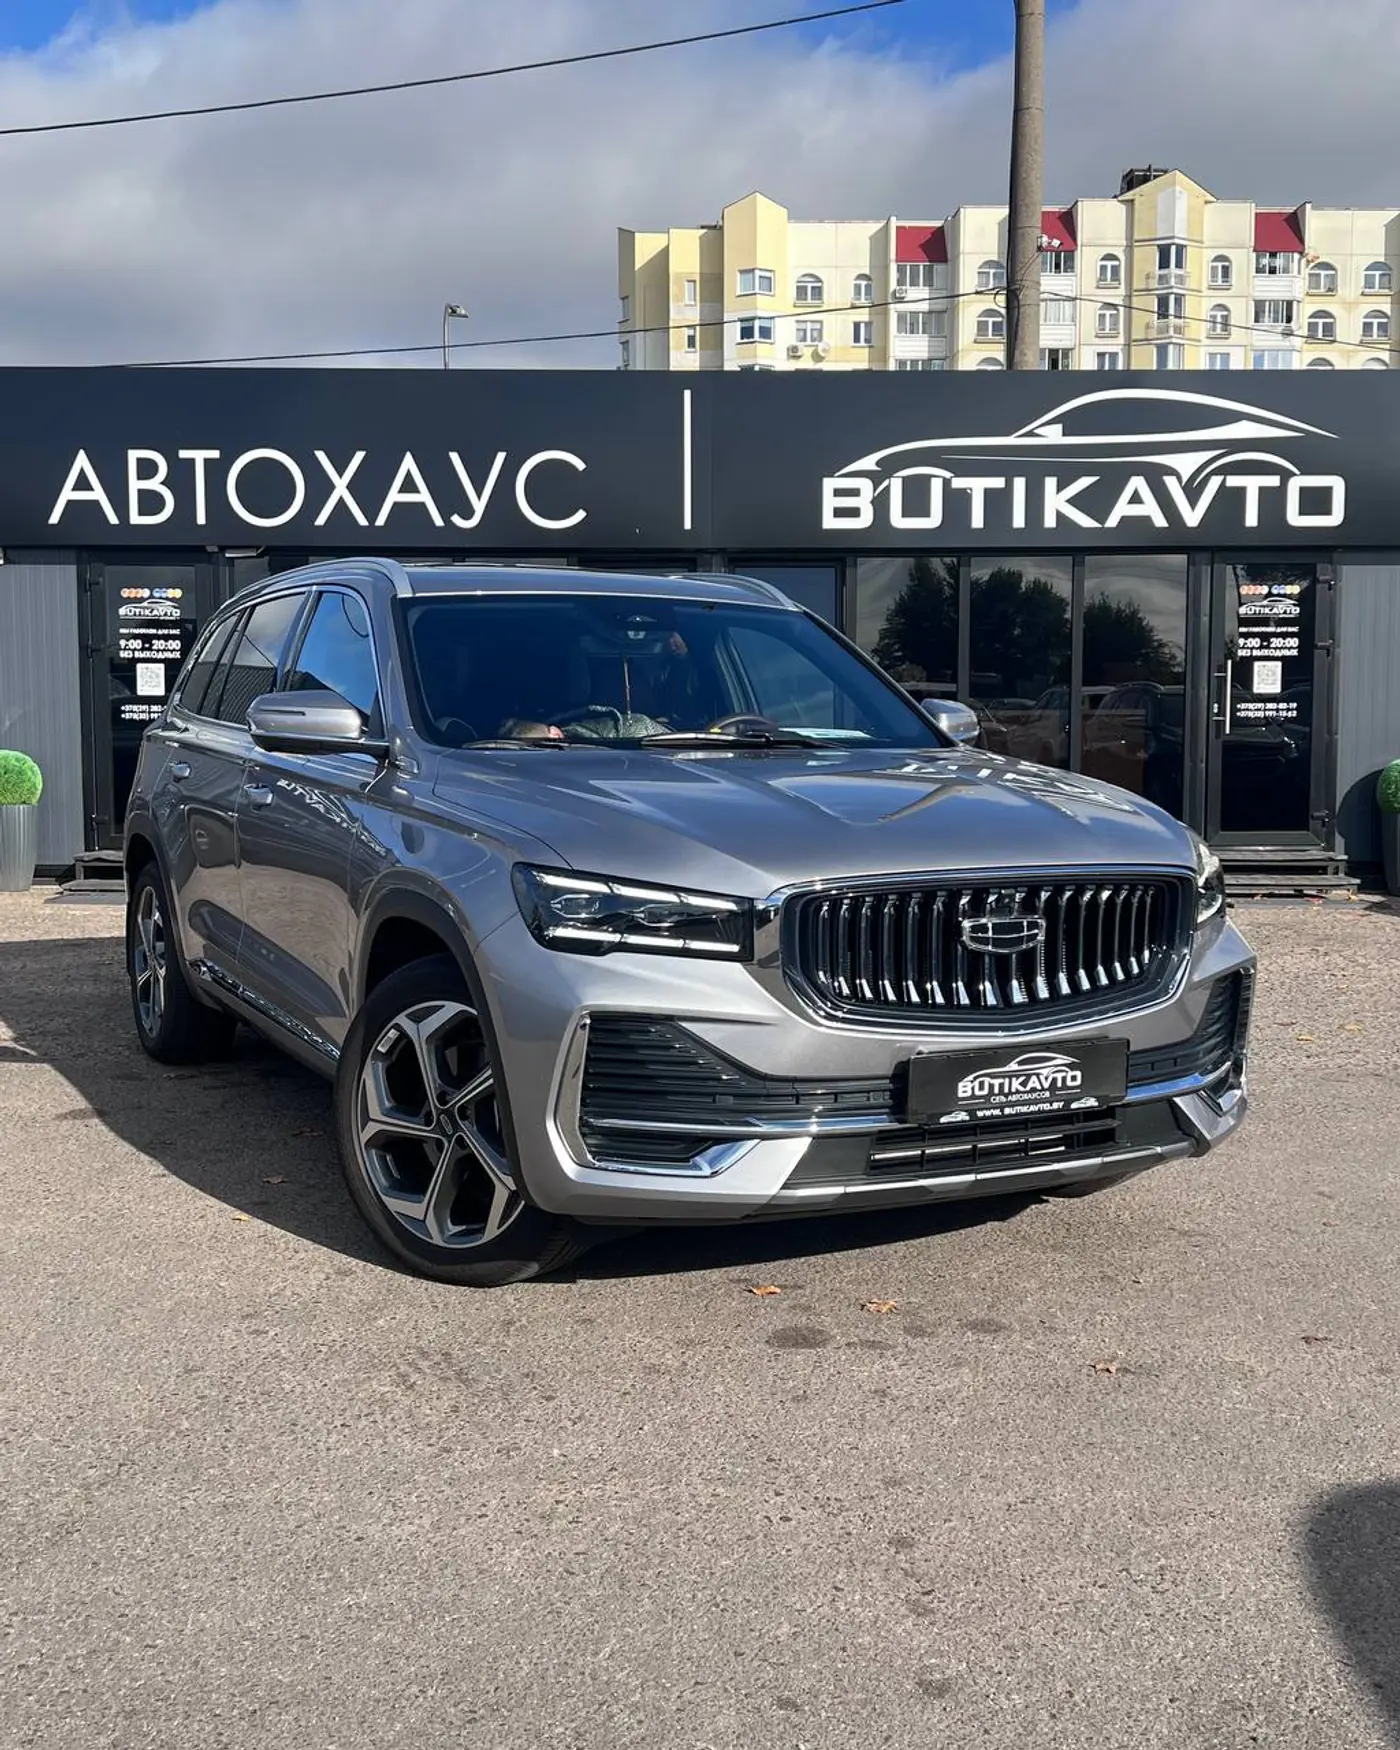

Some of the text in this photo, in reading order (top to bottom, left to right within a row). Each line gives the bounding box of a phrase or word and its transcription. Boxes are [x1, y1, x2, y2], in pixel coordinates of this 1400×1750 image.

[48, 447, 588, 530] АВТОХАУС
[821, 474, 1347, 530] BUTIKAVTO
[118, 607, 181, 617] BUTIKAVTO
[1238, 606, 1300, 615] BUTIKAVTO
[119, 639, 142, 650] 9:00
[151, 639, 182, 650] 20:00
[1238, 637, 1261, 648] 9:00
[1270, 637, 1299, 648] 20:00
[119, 650, 181, 659] БЕЗ ВЫХОДНЫХ
[1237, 648, 1299, 657] БЕЗ ВЫХОДНЫХ
[957, 1070, 1082, 1098] BUTIKAVTO
